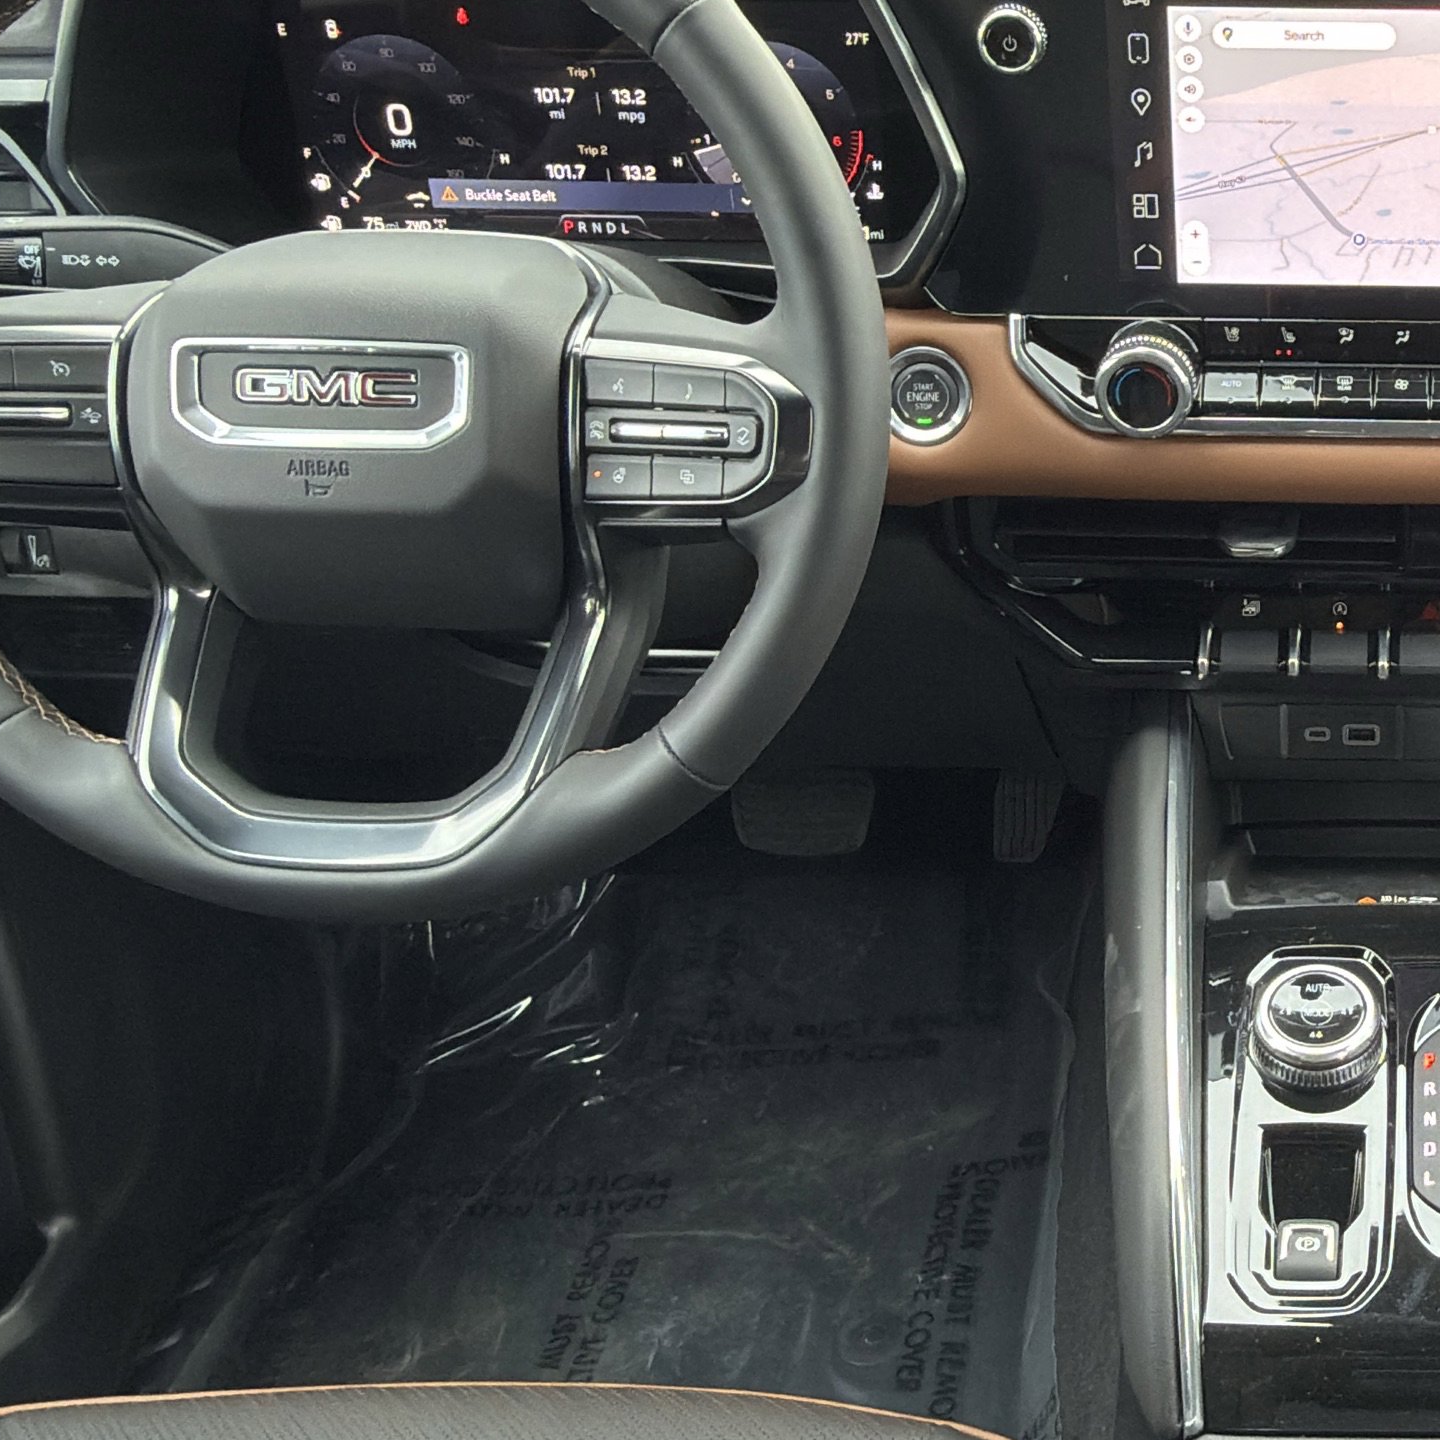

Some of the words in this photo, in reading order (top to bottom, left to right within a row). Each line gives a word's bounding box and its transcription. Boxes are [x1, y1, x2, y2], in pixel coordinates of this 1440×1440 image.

[276, 22, 288, 37] E
[1283, 28, 1326, 43] Search
[417, 62, 437, 74] 100
[786, 58, 796, 70] 4
[566, 66, 589, 79] Trip
[532, 86, 575, 105] 101.7
[610, 87, 647, 106] 13.2
[386, 102, 414, 137] 0
[548, 108, 566, 120] mi
[617, 110, 646, 125] mpg
[390, 138, 418, 150] MPH
[832, 136, 843, 147] 6
[576, 143, 600, 157] Trip
[499, 152, 511, 165] H
[544, 163, 587, 181] 101.7
[621, 164, 658, 181] 13.2
[464, 187, 504, 203] Buckle
[504, 189, 531, 203] Seat
[532, 189, 558, 203] Belt
[563, 220, 575, 234] P
[23, 244, 41, 255] OFF
[234, 367, 418, 407] GMC
[912, 382, 935, 391] START
[1221, 379, 1243, 388] AUTO
[906, 391, 940, 402] ENGINE
[914, 403, 933, 411] STOP
[286, 458, 350, 477] AIRBAG
[1423, 1052, 1437, 1070] P
[1423, 1081, 1437, 1097] R
[1423, 1111, 1437, 1127] N
[1423, 1141, 1437, 1157] D
[1423, 1171, 1437, 1187] L
